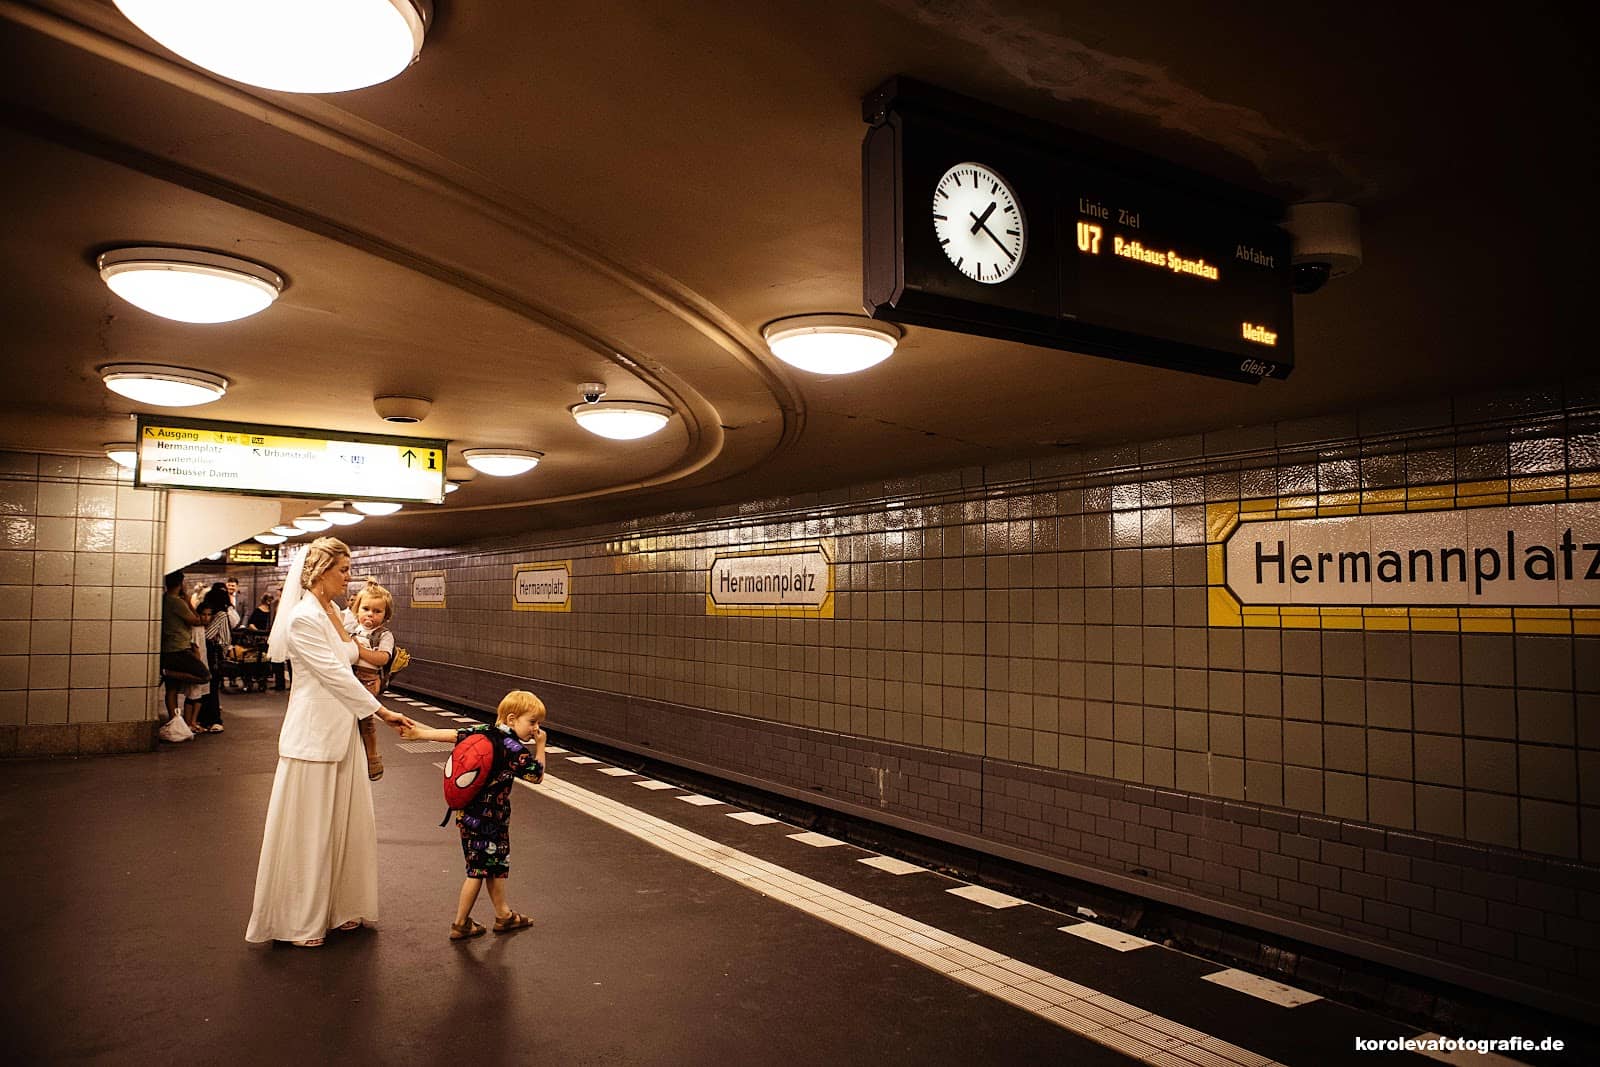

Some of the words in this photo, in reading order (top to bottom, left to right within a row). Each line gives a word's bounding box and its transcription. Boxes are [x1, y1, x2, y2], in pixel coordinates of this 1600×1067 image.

[1079, 198, 1109, 219] Linie
[1118, 209, 1140, 229] Ziel
[1076, 221, 1102, 254] U7
[1113, 236, 1166, 267] Rathaus
[1166, 250, 1219, 280] Spandau
[1235, 244, 1274, 269] Abfahrt
[1242, 322, 1278, 346] Weiter
[1240, 359, 1265, 377] Gleis
[1265, 364, 1276, 377] 2
[157, 428, 199, 442] Ausgang
[157, 440, 223, 454] Hermannplatz
[209, 469, 239, 479] Damm
[519, 578, 564, 599] Hermannplatz
[720, 565, 815, 599] Hermannplatz
